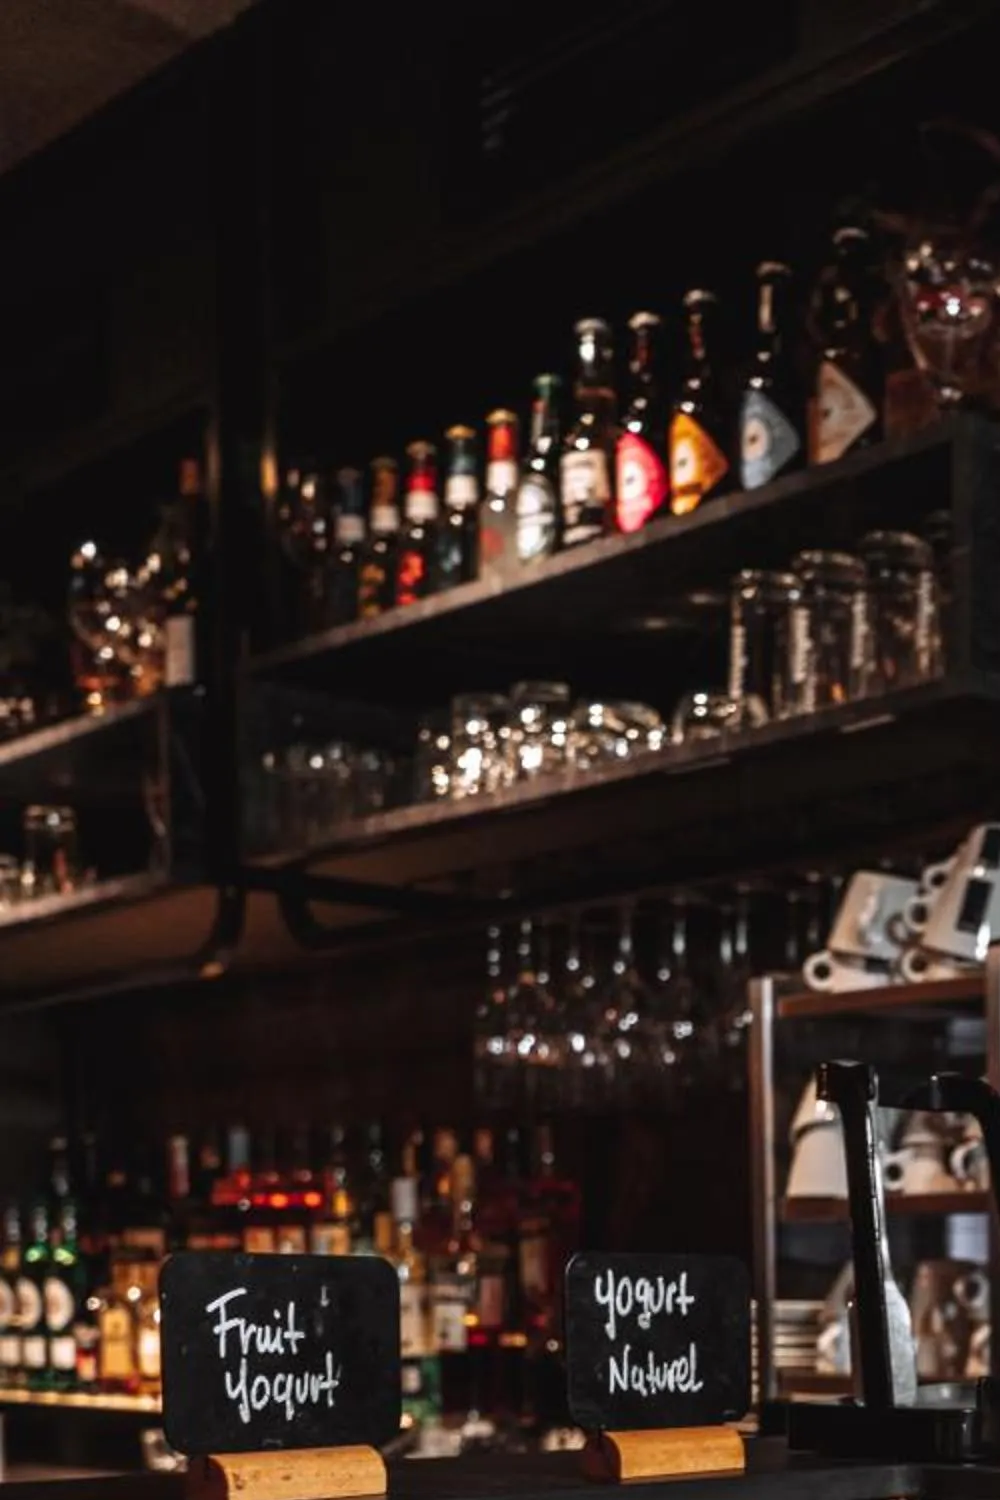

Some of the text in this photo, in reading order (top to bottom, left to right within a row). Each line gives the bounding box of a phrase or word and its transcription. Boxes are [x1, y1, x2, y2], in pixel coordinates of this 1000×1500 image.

[205, 1287, 306, 1359] Fruit
[595, 1268, 695, 1340] Yogurt
[224, 1350, 341, 1425] Yogurt
